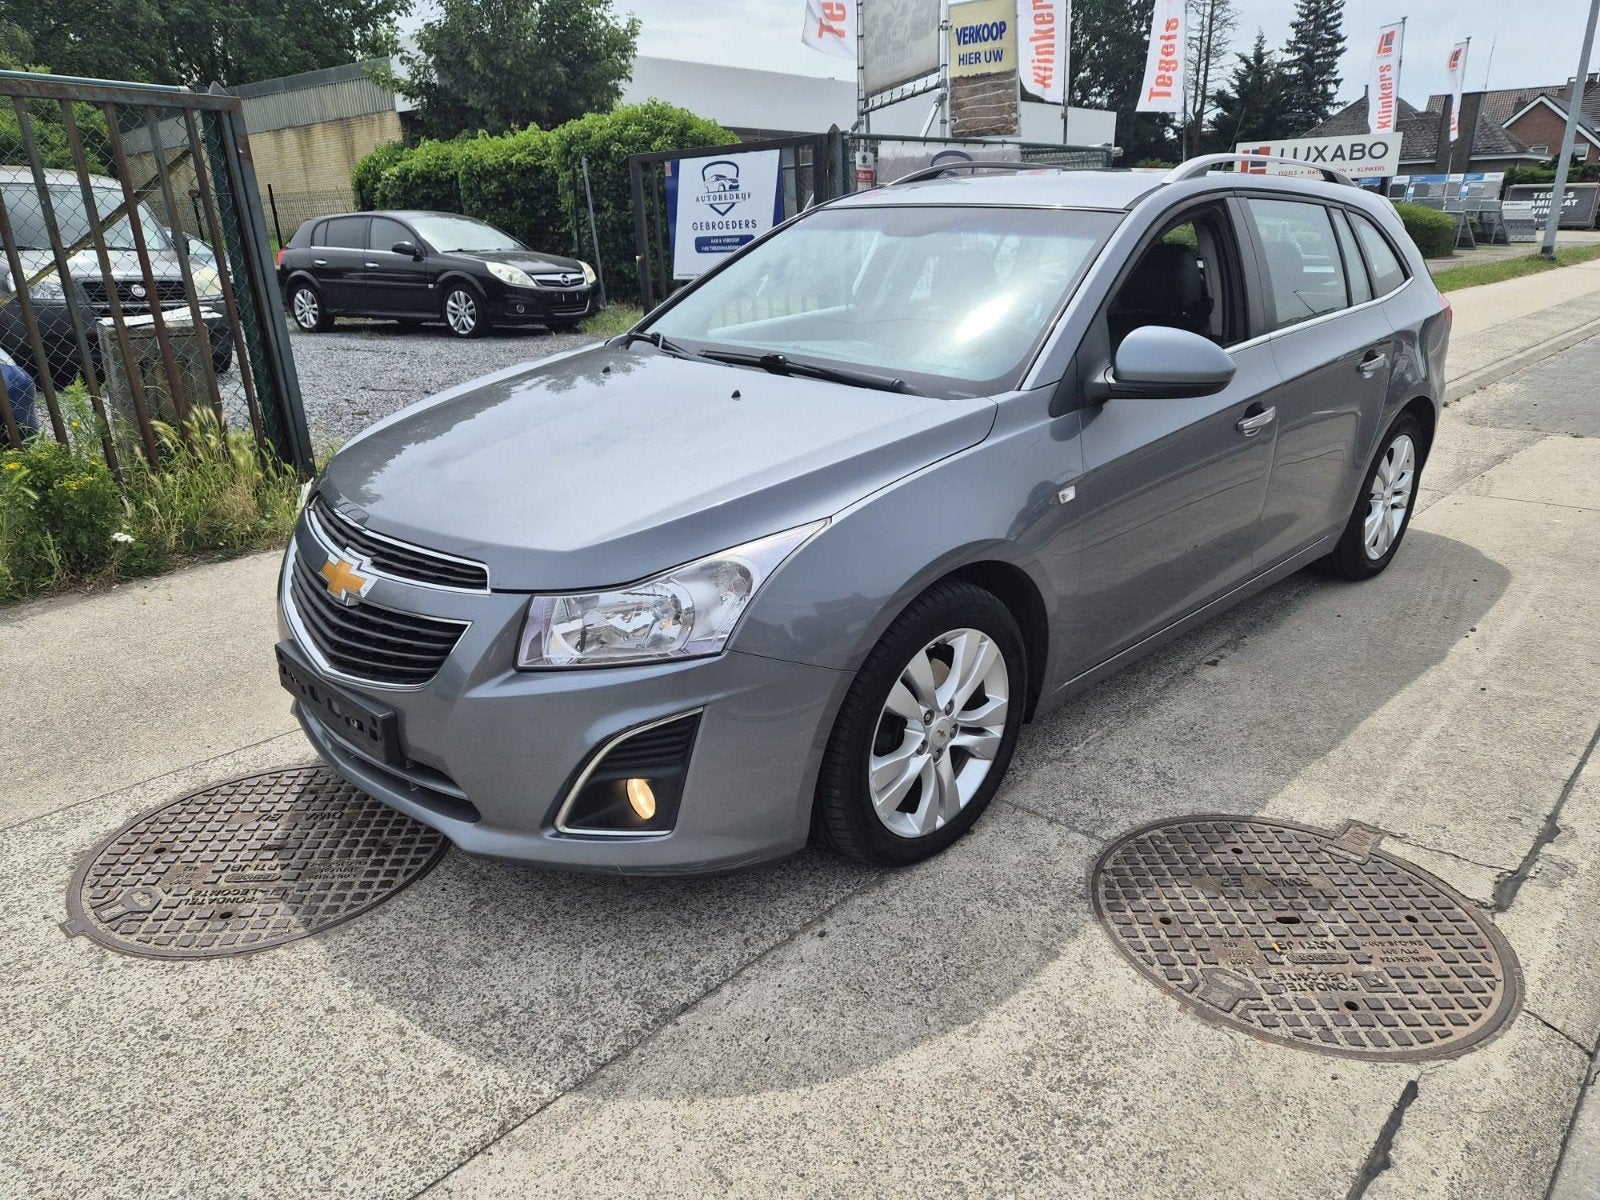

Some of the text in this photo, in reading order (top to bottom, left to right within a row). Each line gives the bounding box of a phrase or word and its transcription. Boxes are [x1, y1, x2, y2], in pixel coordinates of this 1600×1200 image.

[955, 20, 1007, 46] VERKOOP
[958, 48, 1004, 67] HIER UW
[1148, 17, 1180, 102] Tegels
[1376, 63, 1394, 131] Klinkers
[1278, 140, 1390, 165] LUXABO
[1356, 165, 1386, 173] KLINKERS
[695, 192, 752, 203] AUTOBEDRIJF
[692, 219, 758, 231] GEBROEDERS
[193, 888, 259, 897] LECOMTE
[182, 896, 255, 906] FONDATEL
[1274, 972, 1348, 983] LECOMTE
[1277, 982, 1359, 993] FONDATEL
